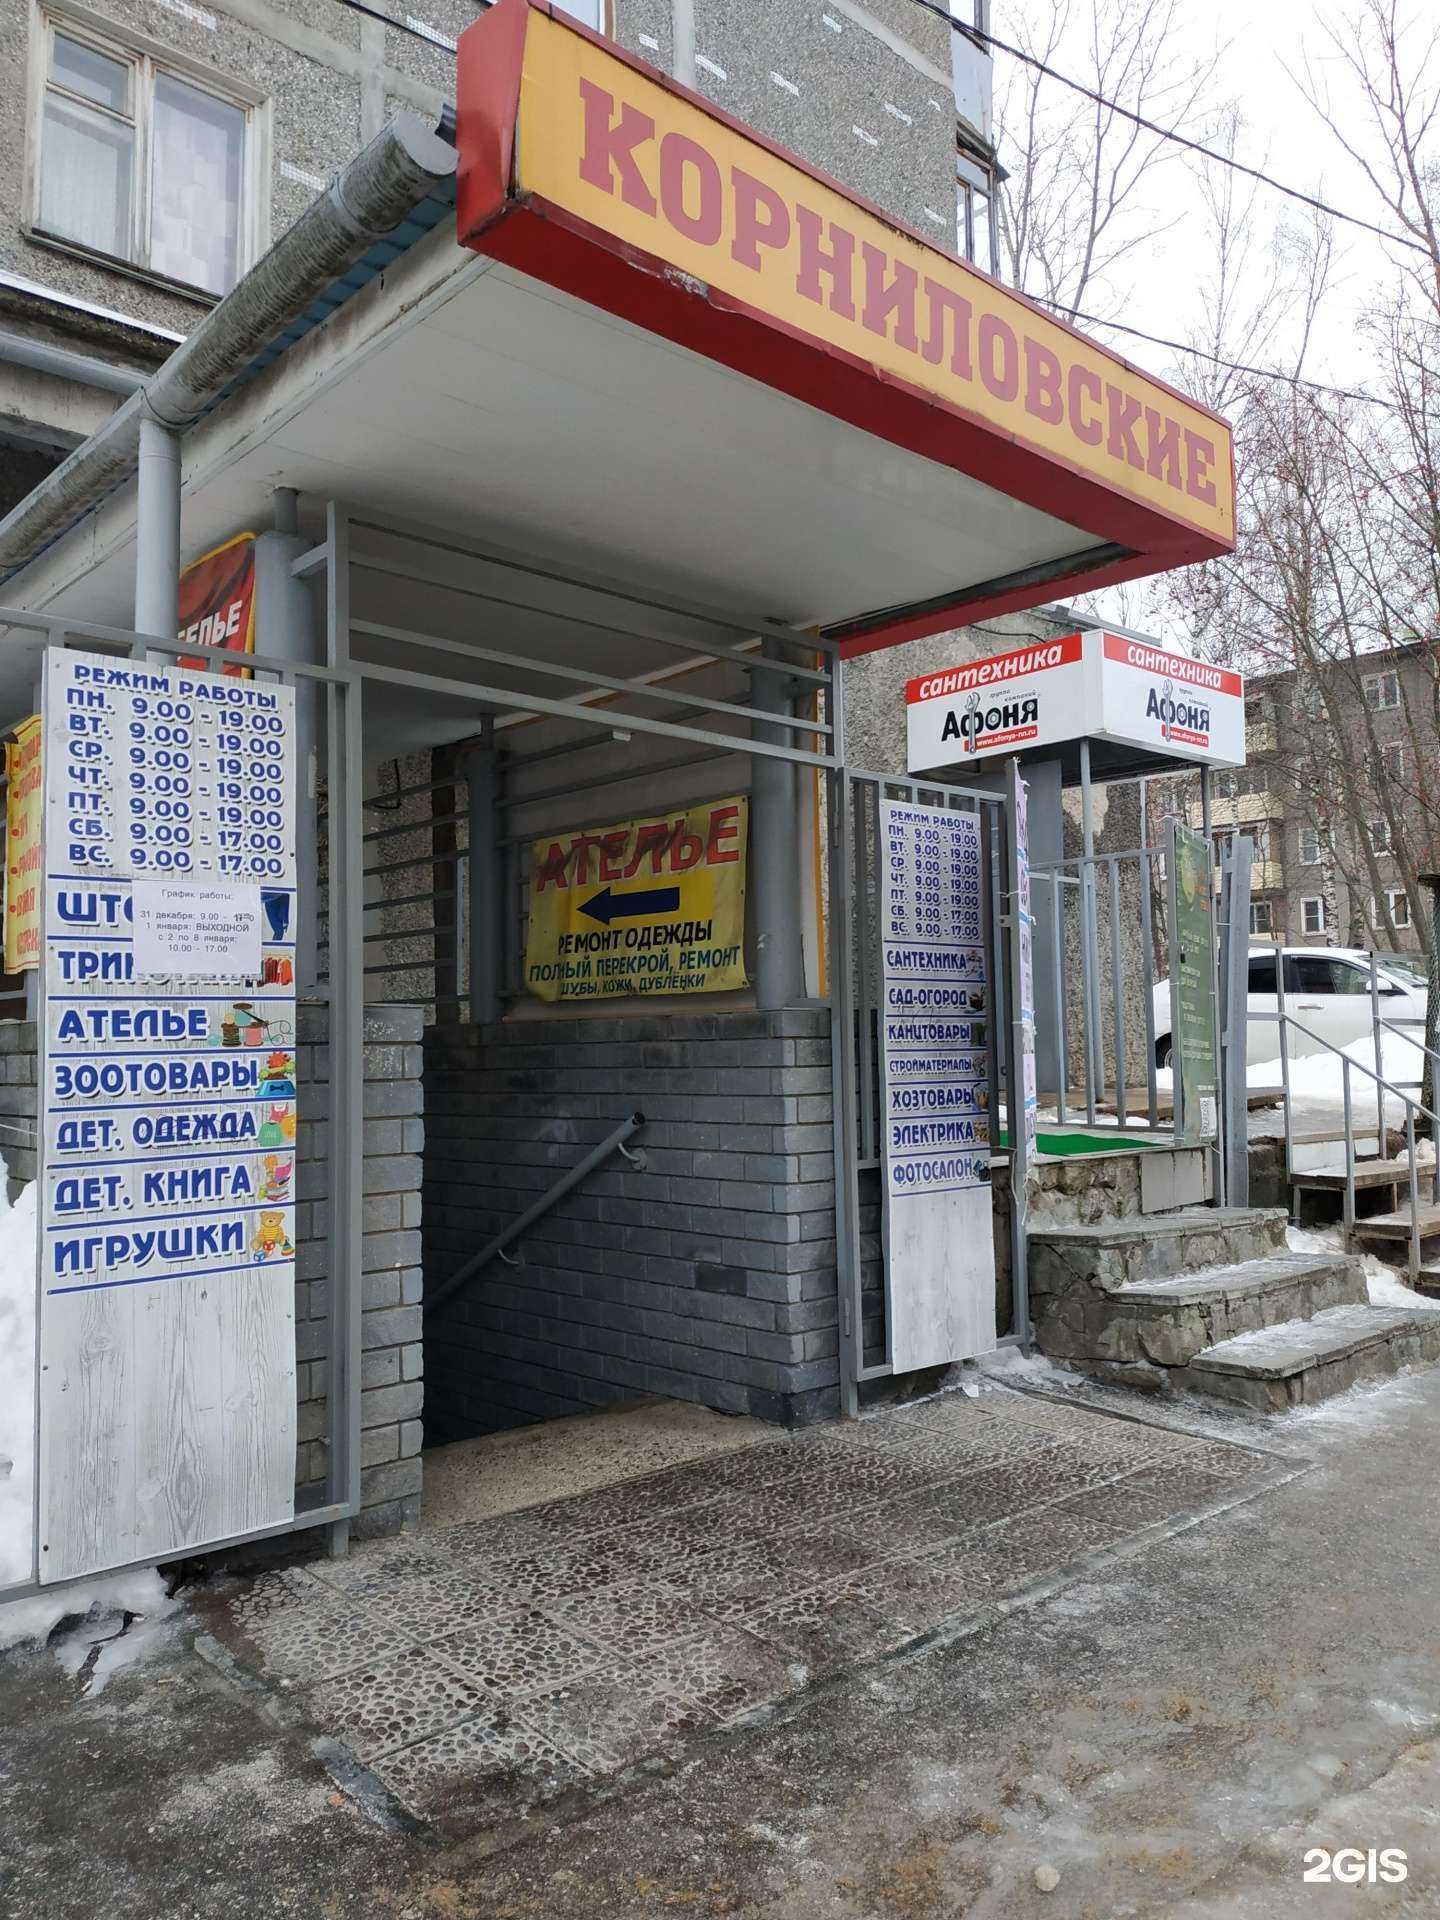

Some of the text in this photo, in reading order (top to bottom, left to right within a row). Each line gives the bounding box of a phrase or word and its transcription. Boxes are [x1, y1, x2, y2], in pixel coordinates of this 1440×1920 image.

[579, 76, 1217, 508] КОРНИЛОВСКИЕ
[919, 643, 1063, 699] сантехника
[1127, 643, 1222, 690] сантехника
[75, 665, 277, 709] РЕЖИМ РАБОТЫ
[67, 688, 112, 709] ПН.
[132, 697, 191, 720] 9.00
[219, 710, 283, 733] 19.00
[941, 698, 1038, 742] Афоня
[1146, 688, 1210, 732] Афоня
[70, 714, 110, 735] ВТ.
[129, 722, 189, 745] 9.00
[217, 734, 281, 755] 19.00
[69, 740, 110, 760] СР.
[129, 747, 189, 769] 9.00
[217, 759, 281, 780] 19.00
[68, 766, 109, 786] ЧТ.
[129, 772, 189, 794] 9.00
[217, 783, 281, 803] 19.00
[68, 792, 109, 811] ПТ.
[129, 798, 189, 818] 9.00
[218, 807, 282, 827] 19.00
[890, 810, 974, 830] РЕЖИМ РАБОТЫ
[68, 818, 110, 837] СБ.
[130, 823, 190, 843] 9.00
[218, 831, 282, 850] 17.00
[888, 825, 908, 837] ПН.
[915, 828, 939, 841] 9.00
[951, 833, 977, 846] 19.00
[69, 844, 110, 863] ВС.
[130, 849, 190, 868] 9.00
[218, 855, 282, 874] 17.00
[536, 806, 739, 892] АТЕЛЬЕ
[890, 841, 907, 852] ВТ.
[914, 844, 939, 856] 9.00
[951, 849, 977, 861] 19.00
[891, 857, 908, 868] СР.
[915, 859, 939, 872] 9.00
[951, 864, 978, 876] 19.00
[161, 889, 195, 899] График
[891, 873, 908, 884] ЧТ.
[915, 875, 939, 887] 9.00
[951, 879, 978, 891] 19.00
[891, 889, 908, 900] ПТ.
[915, 891, 939, 903] 9.00
[951, 895, 978, 907] 19.00
[140, 911, 151, 919] 31
[155, 912, 196, 921] декабря:
[200, 912, 219, 921] 9.00
[157, 924, 191, 932] января:
[196, 922, 250, 932] ВЫХОДНОЙ
[891, 905, 908, 916] СБ.
[915, 907, 940, 918] 9.00
[951, 910, 978, 922] 17.00
[168, 933, 174, 941] 2
[559, 921, 711, 955] РЕМОНТ ОДЕЖДЫ
[891, 921, 908, 932] ВС.
[916, 923, 940, 935] 9.00
[952, 926, 978, 937] 17.00
[168, 944, 192, 952] 10.00
[205, 945, 228, 953] 17.00
[887, 950, 967, 970] САНТЕХНИКА
[529, 946, 741, 982] ПОЛНЫЙ ПЕРЕКРОЙ, РЕМОНТ
[561, 979, 600, 996] ШУБЫ,
[889, 988, 967, 1006] САД-ОГОРОД
[58, 1009, 207, 1038] АТЕЛЬЕ
[888, 1024, 970, 1040] КАНЦТОВАРЫ
[55, 1060, 257, 1095] ЗООТОВАРЫ
[889, 1058, 971, 1073] СТРОЙМАТЕРИАЛЫ
[892, 1087, 974, 1108] ХОЗТОВАРЫ
[56, 1112, 256, 1149] ДЕТ. ОДЕЖДА
[893, 1121, 974, 1146] ЭЛЕКТРИКА
[893, 1157, 972, 1183] ФОТОСАЛОН
[54, 1165, 251, 1211] ДЕТ. КНИГА
[54, 1222, 243, 1273] ИГРУШКИ
